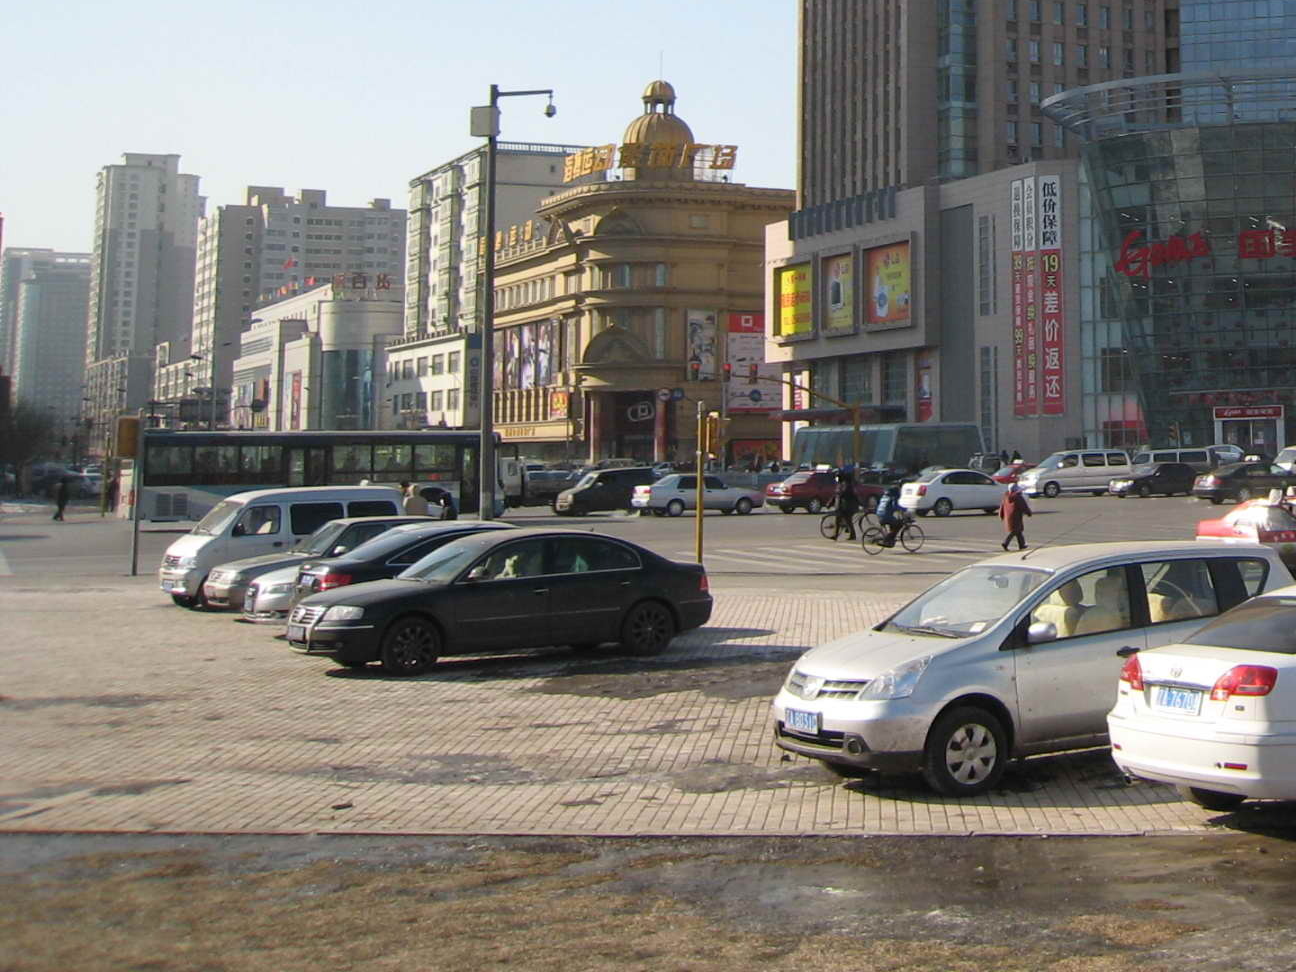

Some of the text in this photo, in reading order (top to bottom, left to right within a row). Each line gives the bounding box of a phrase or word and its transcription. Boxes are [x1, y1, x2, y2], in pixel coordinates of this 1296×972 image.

[1041, 181, 1058, 246] 低价保障
[1042, 254, 1060, 398] 19天差价返还
